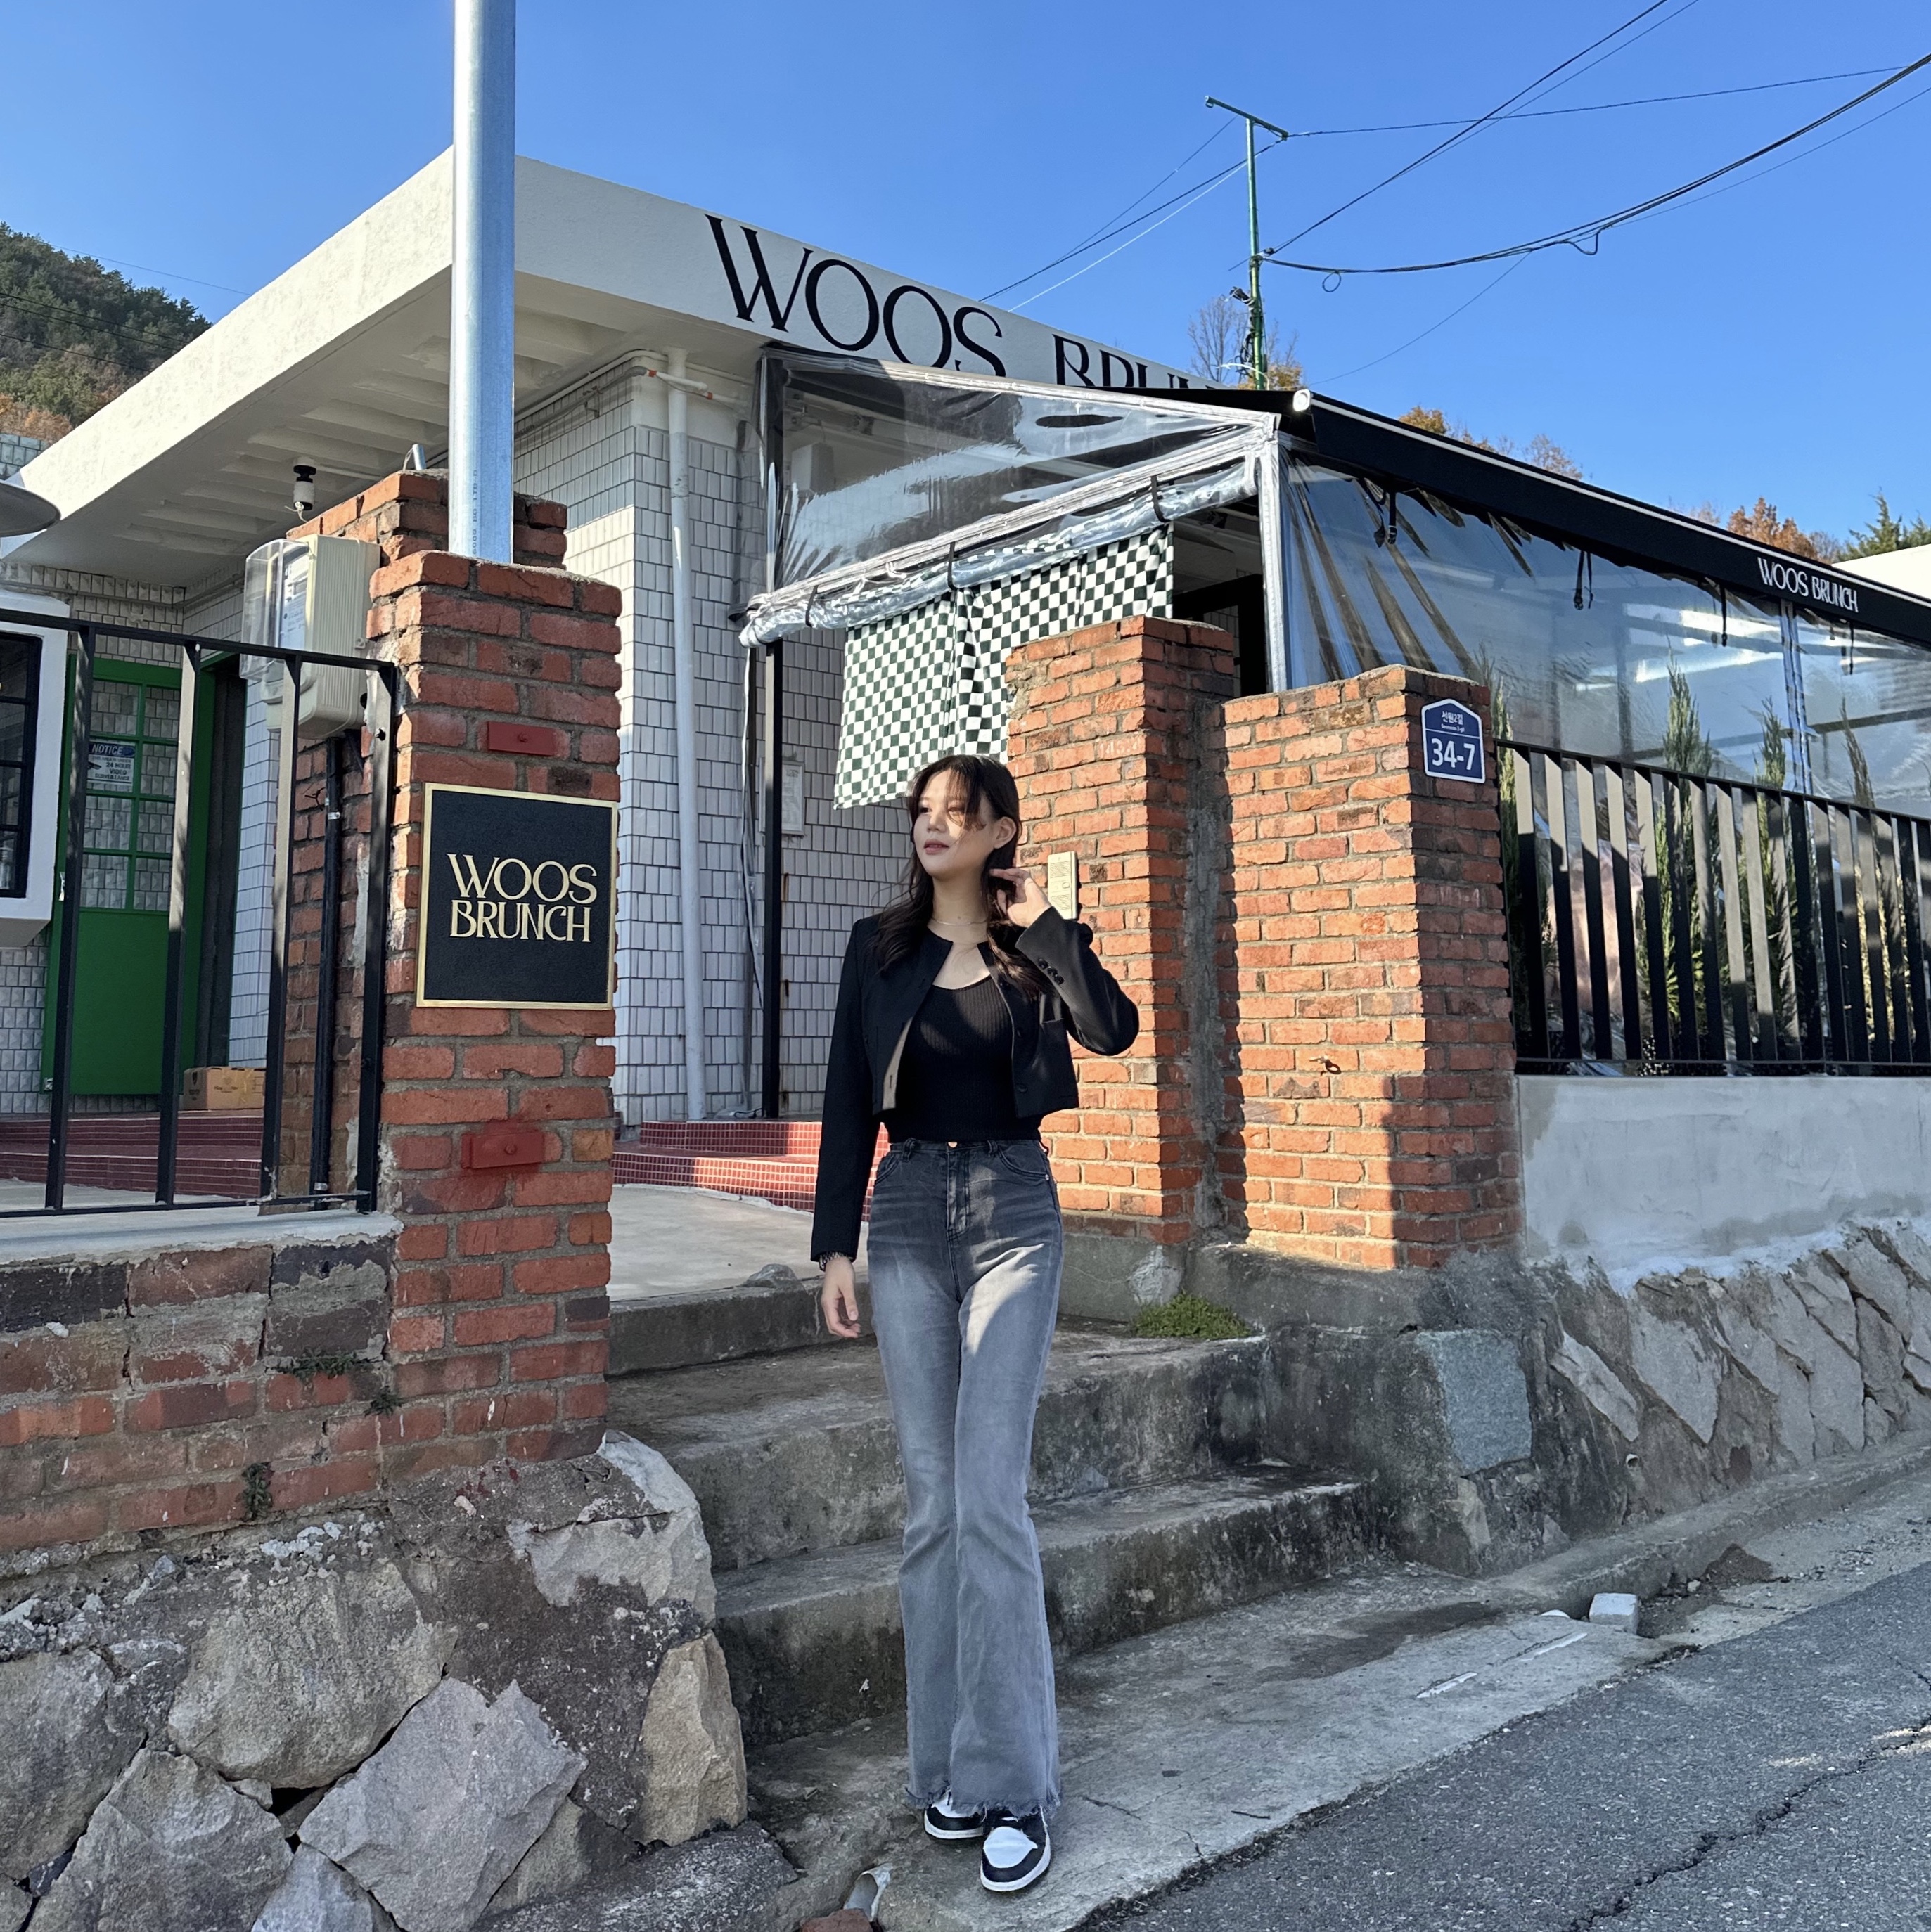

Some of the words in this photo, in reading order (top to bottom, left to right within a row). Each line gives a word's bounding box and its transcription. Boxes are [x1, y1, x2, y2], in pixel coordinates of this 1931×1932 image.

[705, 214, 1006, 378] WOOS
[1757, 557, 1809, 597] WOOS
[1811, 576, 1859, 613] BRUNCH
[92, 744, 123, 755] NOTICE
[1431, 738, 1475, 771] 34-7
[446, 853, 598, 904] WOOS
[449, 899, 592, 943] BRUNCH
